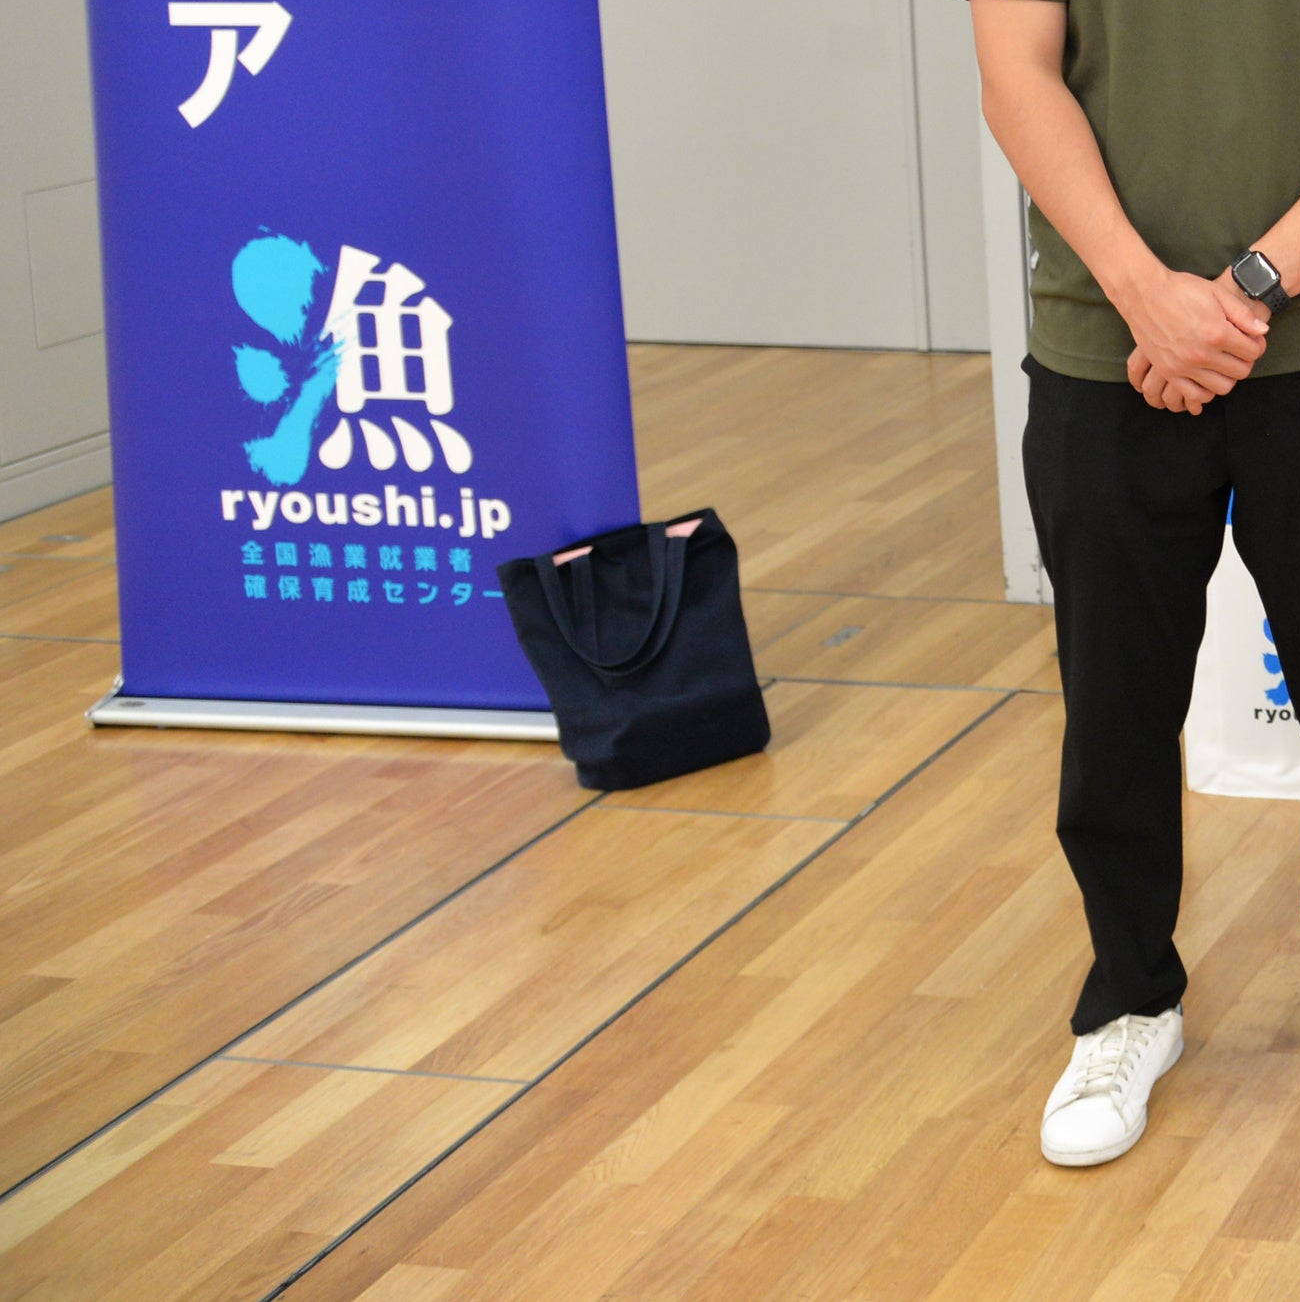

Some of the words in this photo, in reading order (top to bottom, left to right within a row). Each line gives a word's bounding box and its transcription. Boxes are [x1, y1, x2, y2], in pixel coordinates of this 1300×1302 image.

[220, 485, 511, 539] ryoushi.jp
[241, 540, 473, 573] 全国漁業就業者
[243, 574, 505, 606] 確保育成センター
[1254, 708, 1297, 723] ryo
